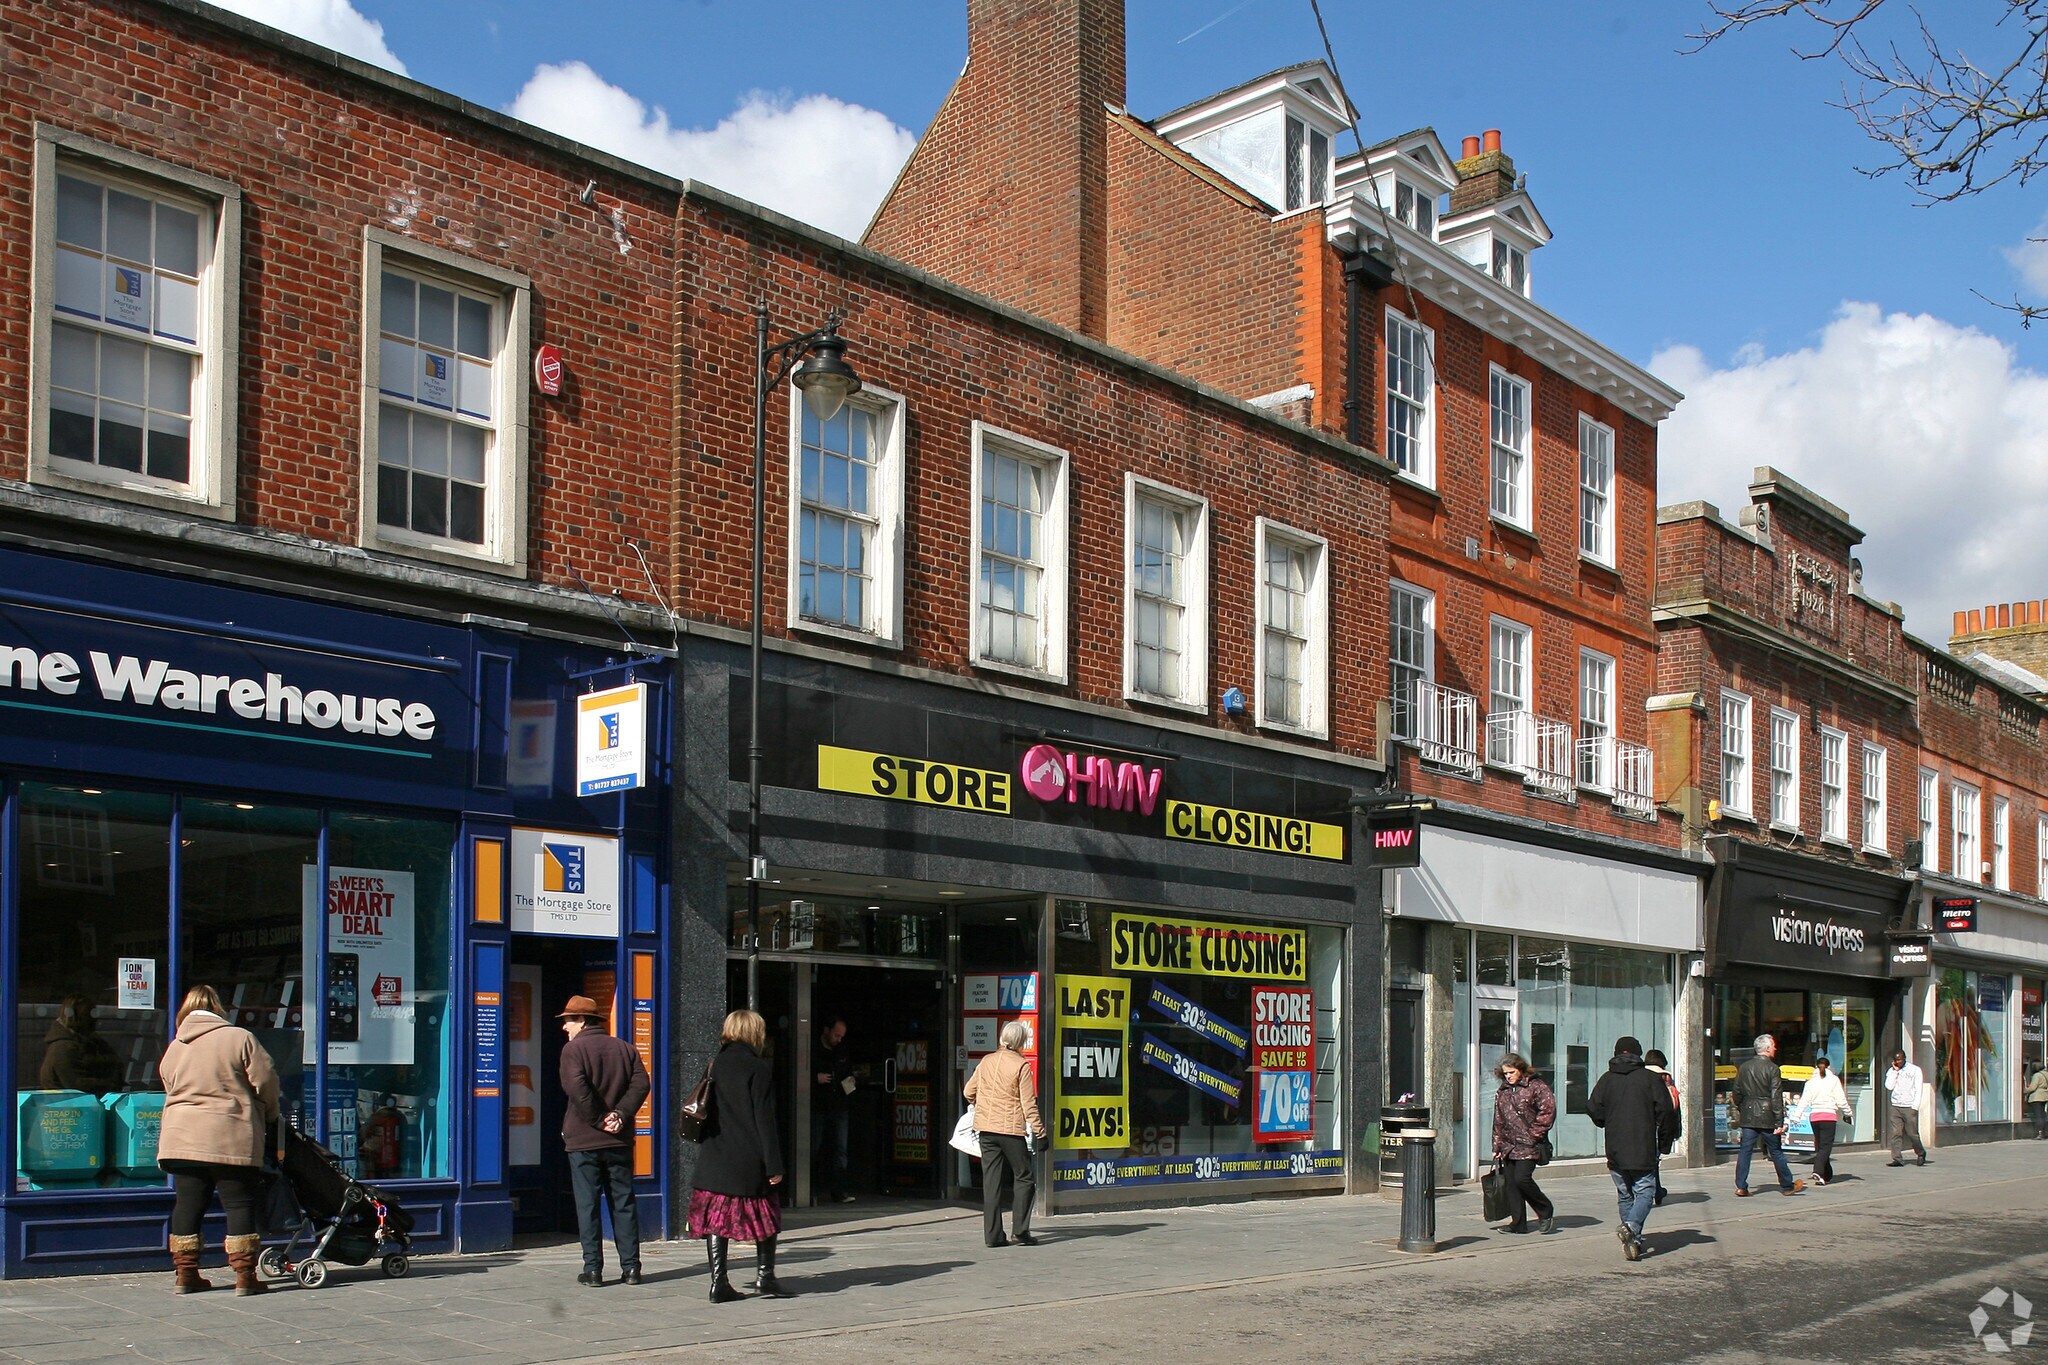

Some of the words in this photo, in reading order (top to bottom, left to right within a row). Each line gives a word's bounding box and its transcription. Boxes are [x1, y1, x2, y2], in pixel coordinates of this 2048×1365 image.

[90, 651, 436, 741] Warehouse
[610, 713, 618, 747] TMS
[872, 756, 1007, 811] STORE
[1066, 752, 1162, 816] HMV
[1172, 803, 1311, 853] CLOSING!
[1375, 830, 1412, 848] HMV
[569, 848, 581, 891] TMS
[339, 875, 384, 892] WEEK'S
[328, 890, 395, 917] SMART
[515, 894, 534, 906] The
[537, 896, 583, 911] Mortgage
[587, 900, 612, 911] Store
[342, 915, 383, 936] DEAL
[1772, 909, 1812, 945] vision
[1814, 918, 1864, 955] express
[1114, 919, 1191, 969] STORE
[1200, 927, 1302, 976] CLOSING!
[1898, 944, 1924, 953] vision
[124, 963, 142, 973] JOIN
[1893, 955, 1927, 964] express
[126, 980, 147, 990] TEAM
[129, 973, 142, 981] OUR
[380, 981, 396, 992] £20
[1022, 994, 1035, 1006] OFF
[1061, 987, 1124, 1018] LAST
[1255, 991, 1311, 1023] STORE
[1152, 990, 1162, 1001] AT
[1162, 994, 1181, 1013] LEAST
[1196, 1023, 1206, 1032] OFF
[1207, 1020, 1247, 1050] EVERYTHING!
[1023, 1038, 1034, 1050] FF
[1255, 1024, 1311, 1047] CLOSING
[1063, 1046, 1120, 1078] FEW
[1260, 1051, 1293, 1067] SAVE
[1296, 1051, 1306, 1059] UP
[1296, 1059, 1307, 1067] TO
[1143, 1042, 1154, 1054] AT
[1154, 1047, 1173, 1065] LEAST
[1189, 1075, 1198, 1084] OFF
[1199, 1071, 1240, 1099] EVERYTHING!
[43, 1110, 70, 1118] STRAP
[71, 1110, 81, 1118] IN
[59, 1118, 78, 1126] FEEL
[896, 1104, 928, 1124] STORE
[1292, 1103, 1309, 1122] OFF
[1060, 1107, 1123, 1138] DAYS!
[50, 1134, 66, 1142] ALL
[896, 1125, 927, 1140] CLOSING
[51, 1142, 63, 1150] OF
[1053, 1170, 1062, 1180] AT
[1064, 1169, 1085, 1180] LEAST
[1106, 1176, 1115, 1184] OFF
[1117, 1165, 1160, 1178] EVERYTHING!
[1165, 1165, 1174, 1175] AT
[1175, 1163, 1193, 1174] LEAST
[1222, 1160, 1261, 1172] EVERYTHING!
[1263, 1160, 1272, 1170] AT
[1273, 1160, 1289, 1169] LEAST
[1305, 1166, 1314, 1174] OFF
